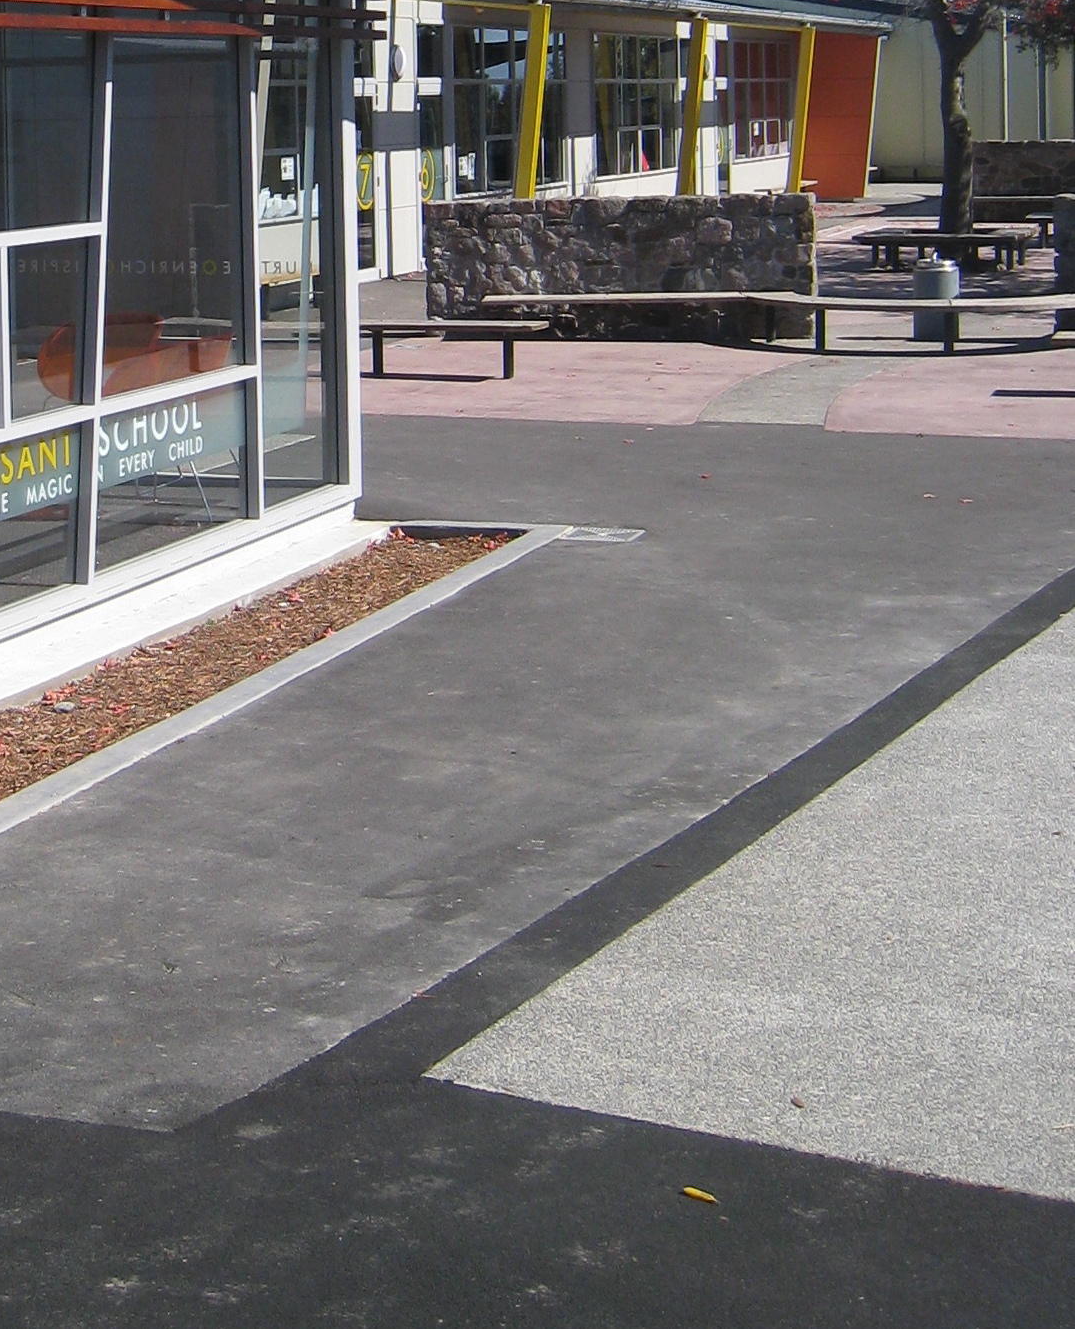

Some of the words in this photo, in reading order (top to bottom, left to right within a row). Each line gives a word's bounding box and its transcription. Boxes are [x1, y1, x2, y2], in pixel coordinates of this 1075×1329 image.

[360, 163, 371, 199] 7
[420, 157, 430, 191] 6
[98, 400, 203, 457] SCHOOL
[25, 473, 74, 507] MAGIC
[118, 448, 156, 477] EVERY
[168, 435, 204, 462] CHILD
